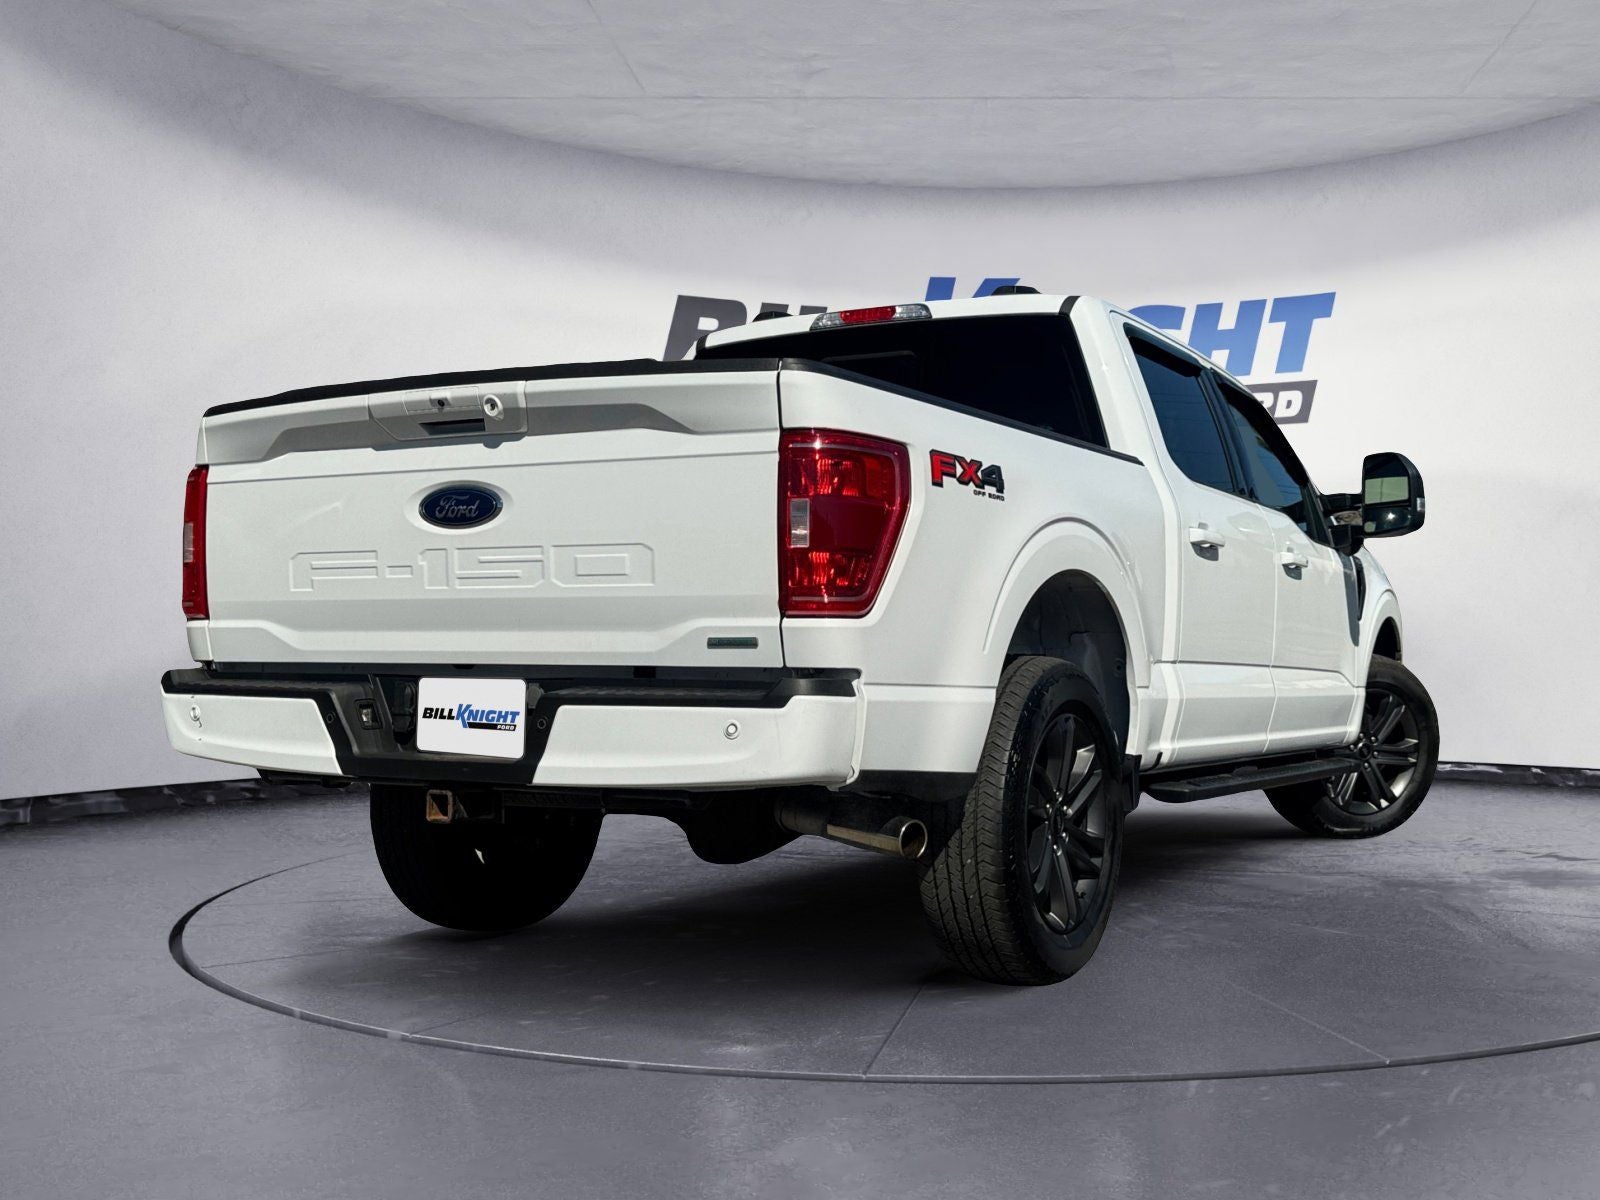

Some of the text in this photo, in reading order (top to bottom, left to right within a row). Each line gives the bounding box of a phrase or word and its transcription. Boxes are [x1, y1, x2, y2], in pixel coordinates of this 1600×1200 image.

[929, 449, 1005, 494] FX4
[435, 494, 480, 519] Ford
[973, 489, 1005, 501] OFF ROAD
[289, 543, 655, 592] F-150
